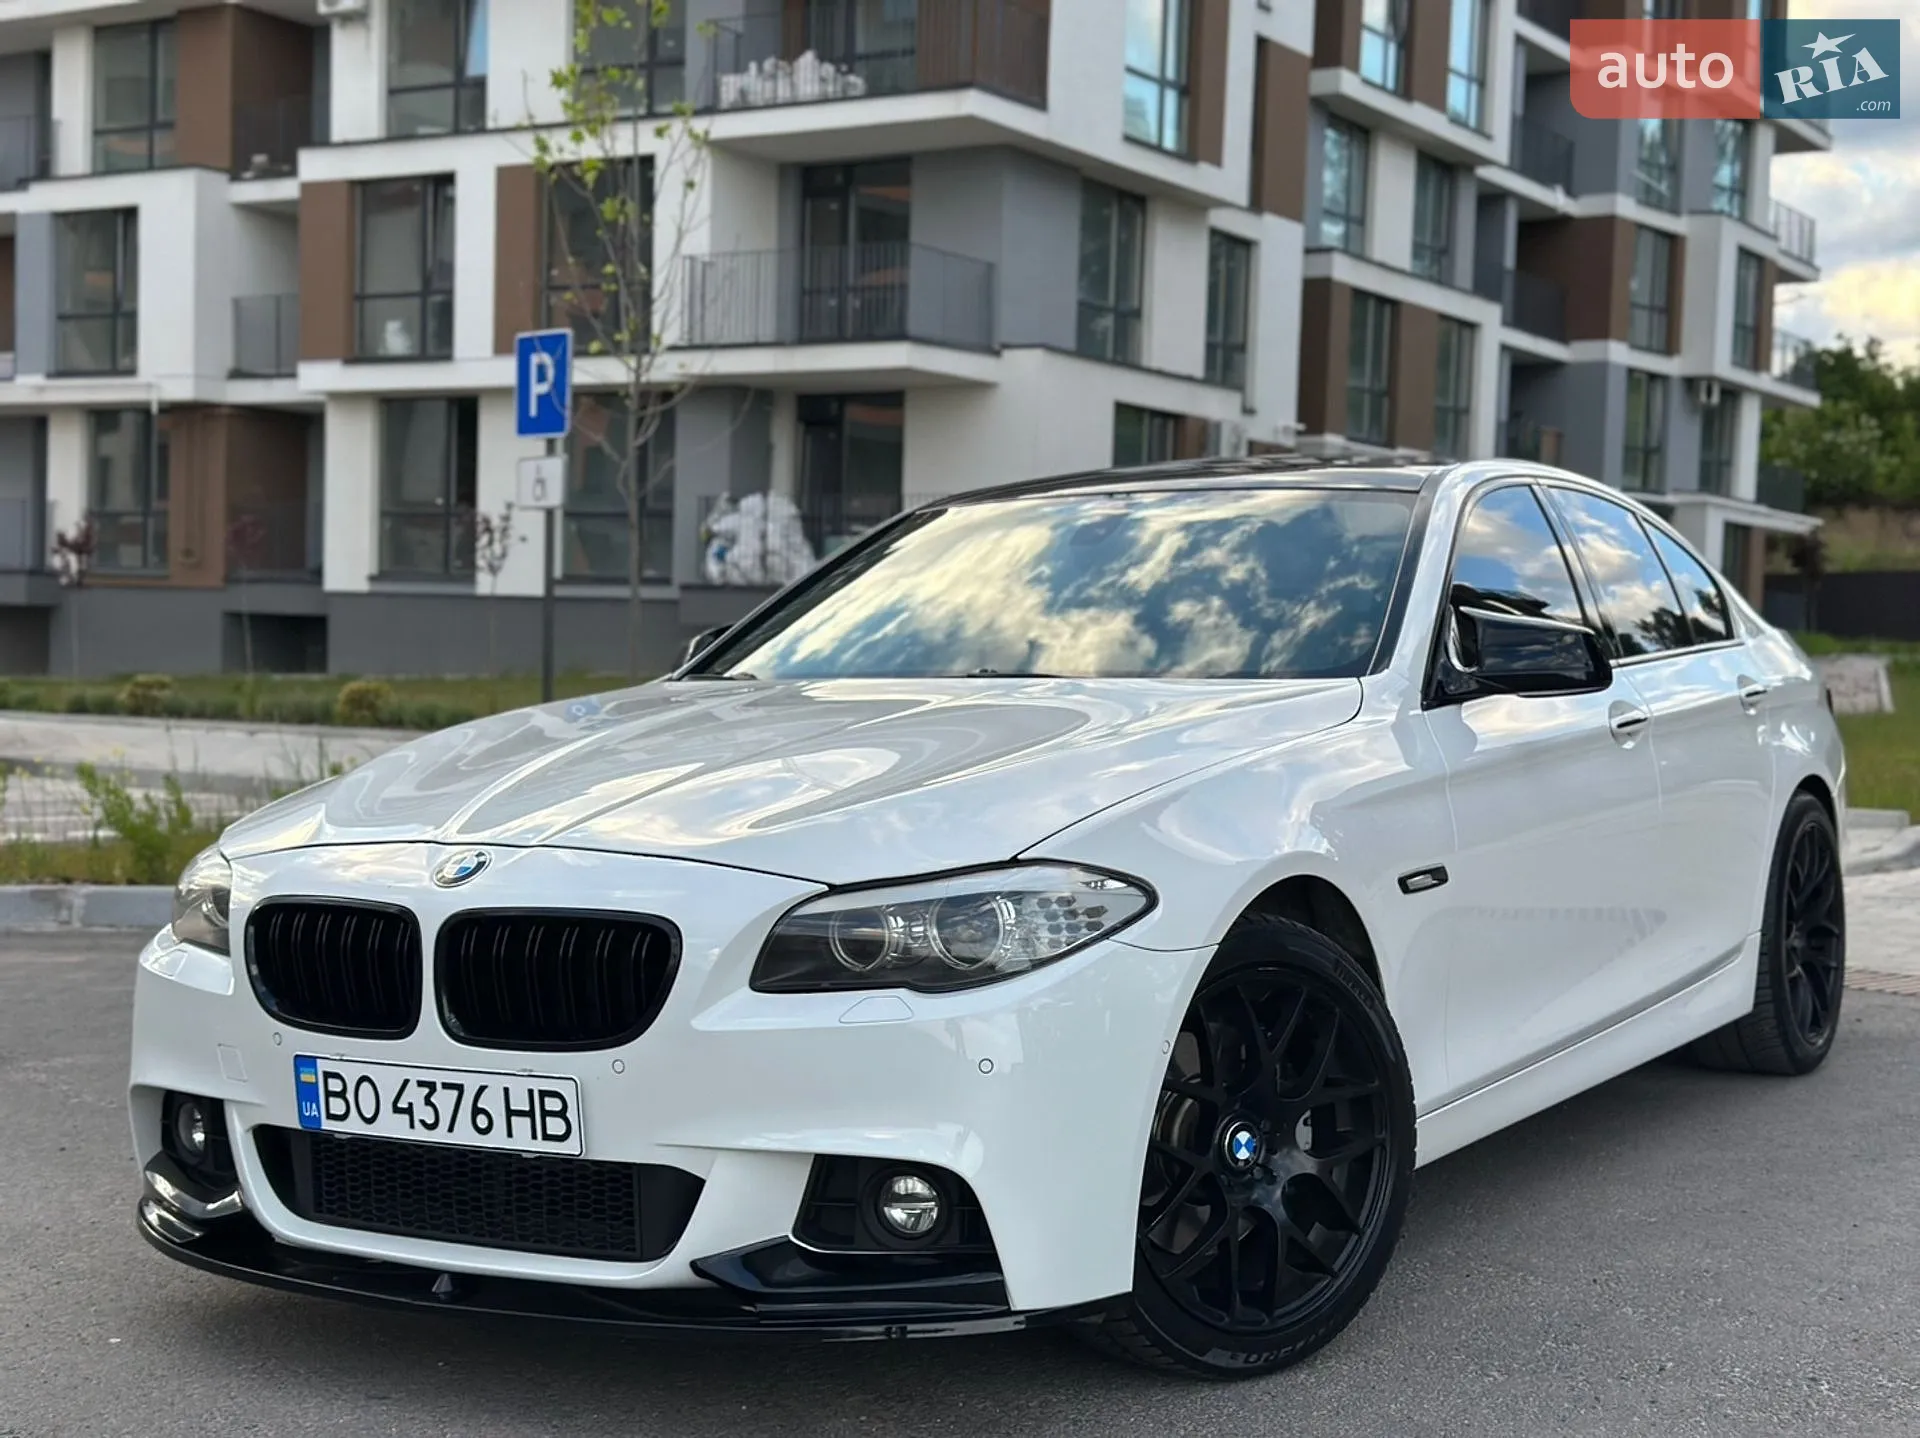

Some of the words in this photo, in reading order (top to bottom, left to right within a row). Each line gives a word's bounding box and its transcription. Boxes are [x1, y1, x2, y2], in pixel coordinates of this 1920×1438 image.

[528, 352, 555, 418] P
[302, 1101, 320, 1117] UA
[322, 1070, 381, 1126] BO
[391, 1078, 495, 1137] 4376
[503, 1086, 573, 1143] HB
